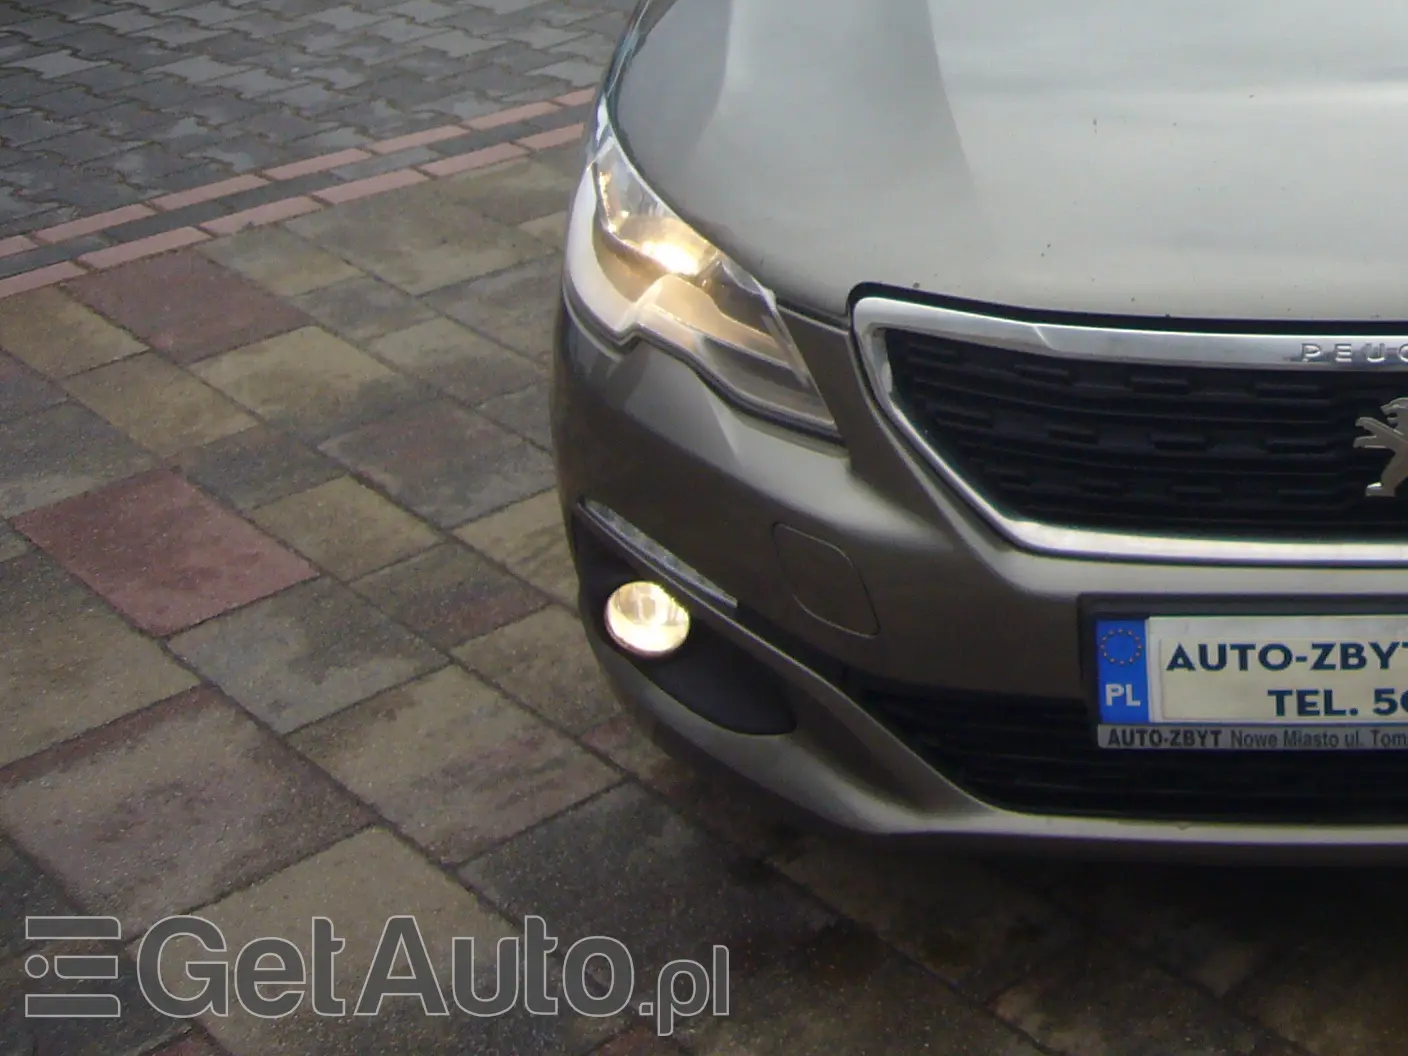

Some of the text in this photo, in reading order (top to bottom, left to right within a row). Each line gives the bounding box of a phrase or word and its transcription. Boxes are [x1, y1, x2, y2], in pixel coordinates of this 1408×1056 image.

[1105, 683, 1141, 707] PL
[1267, 689, 1359, 717] TEL.
[1230, 728, 1278, 747] Nowe
[1283, 728, 1340, 747] Miasto
[1345, 728, 1365, 747] ul.
